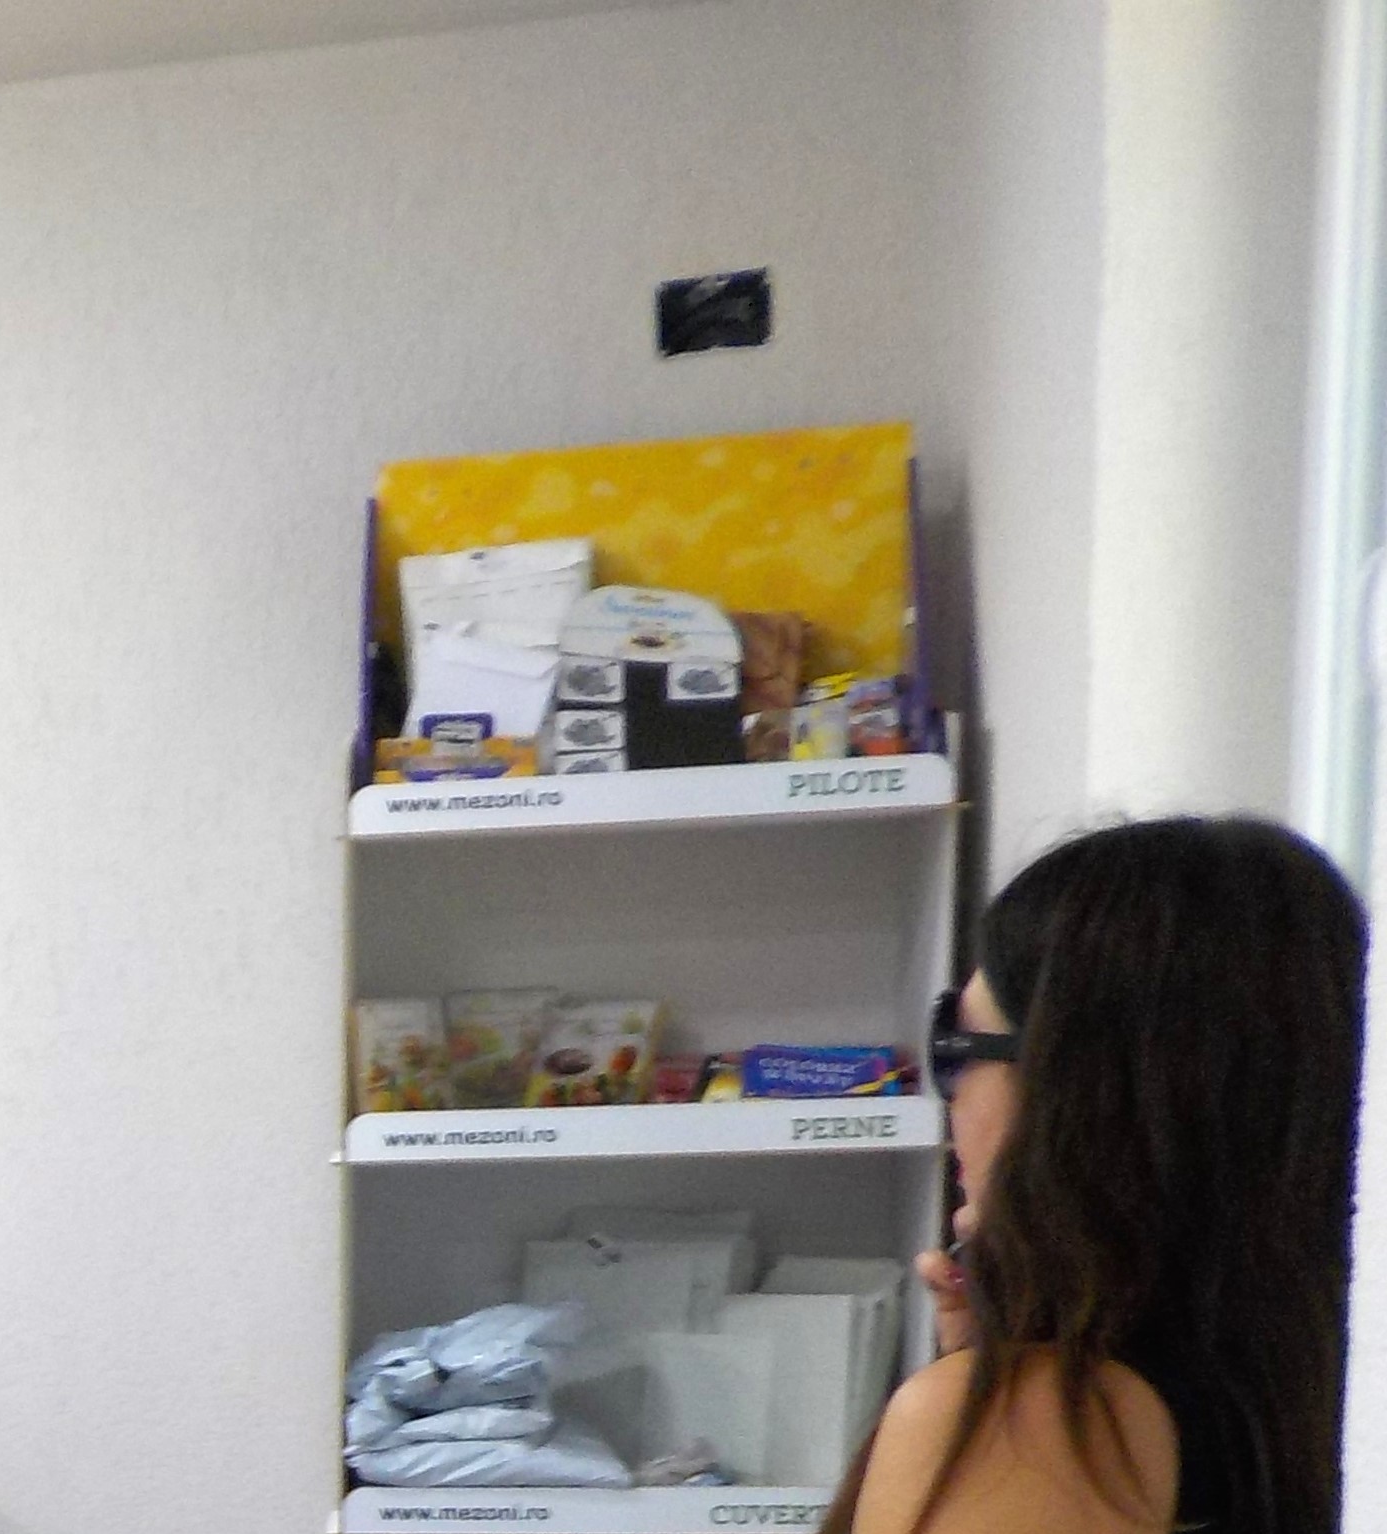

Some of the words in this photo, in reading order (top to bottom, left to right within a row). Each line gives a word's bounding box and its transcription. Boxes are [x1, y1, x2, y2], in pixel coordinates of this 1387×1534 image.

[788, 767, 906, 798] PILOTE
[385, 788, 564, 814] www.mezoni.ro
[383, 1125, 559, 1147] www.mezoni.ro
[790, 1113, 899, 1141] PERNE
[378, 1503, 555, 1522] www.mezoni.ro
